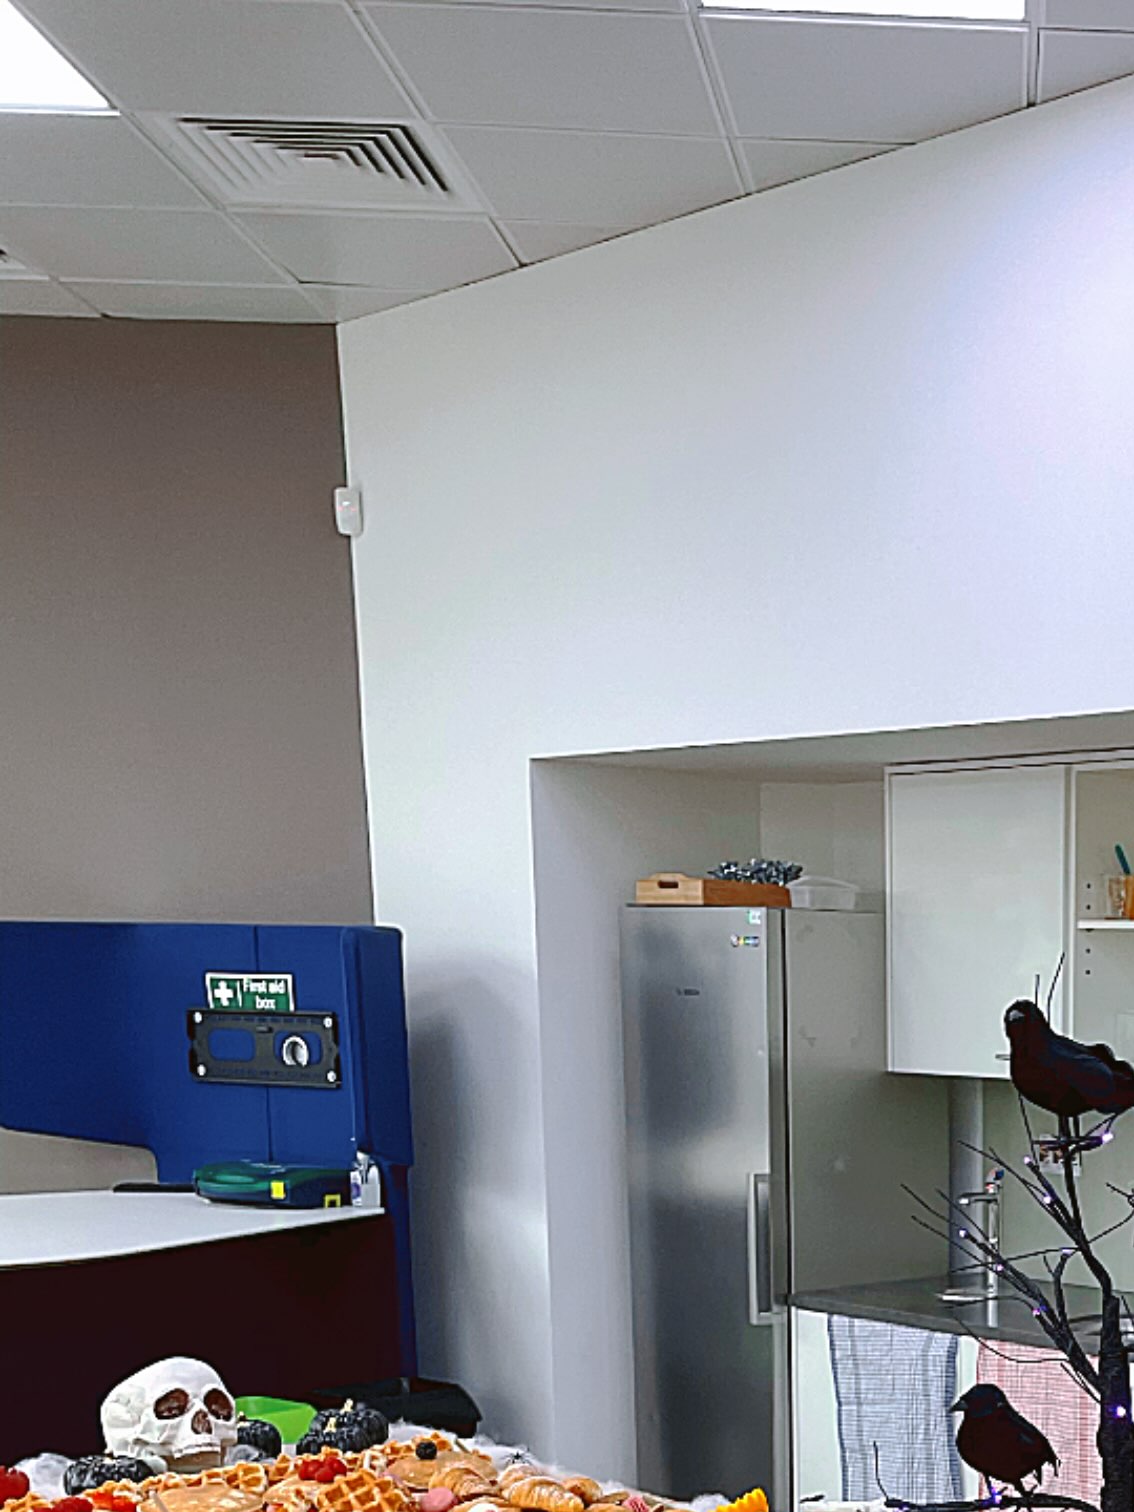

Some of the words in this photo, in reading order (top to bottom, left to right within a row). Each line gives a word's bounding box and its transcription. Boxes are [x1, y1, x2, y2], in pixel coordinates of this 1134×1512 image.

[243, 977, 267, 993] First
[268, 979, 285, 994] aid
[255, 995, 276, 1010] box
